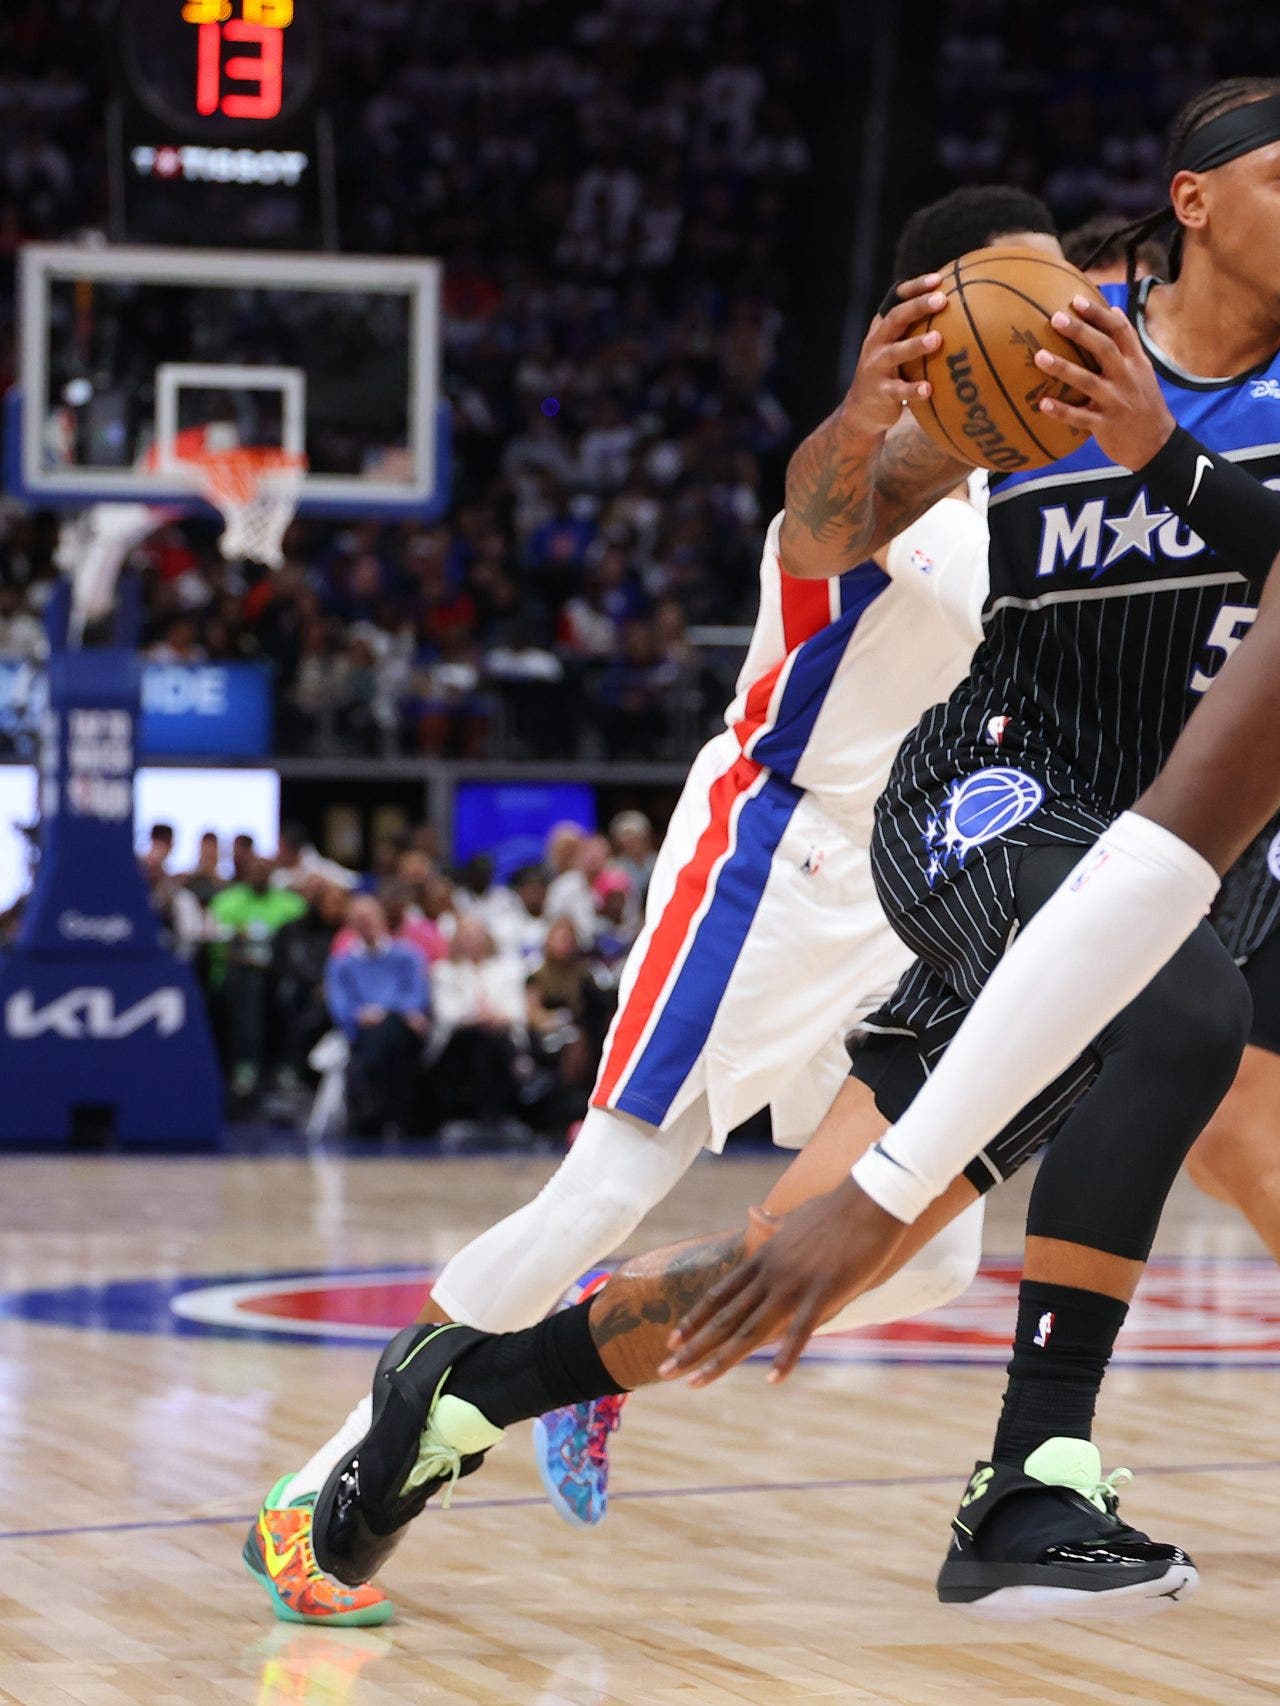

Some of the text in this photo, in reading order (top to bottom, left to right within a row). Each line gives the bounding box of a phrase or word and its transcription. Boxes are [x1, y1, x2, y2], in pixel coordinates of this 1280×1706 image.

[196, 19, 284, 119] 13
[946, 346, 1040, 470] Wilson
[1187, 603, 1260, 695] 5
